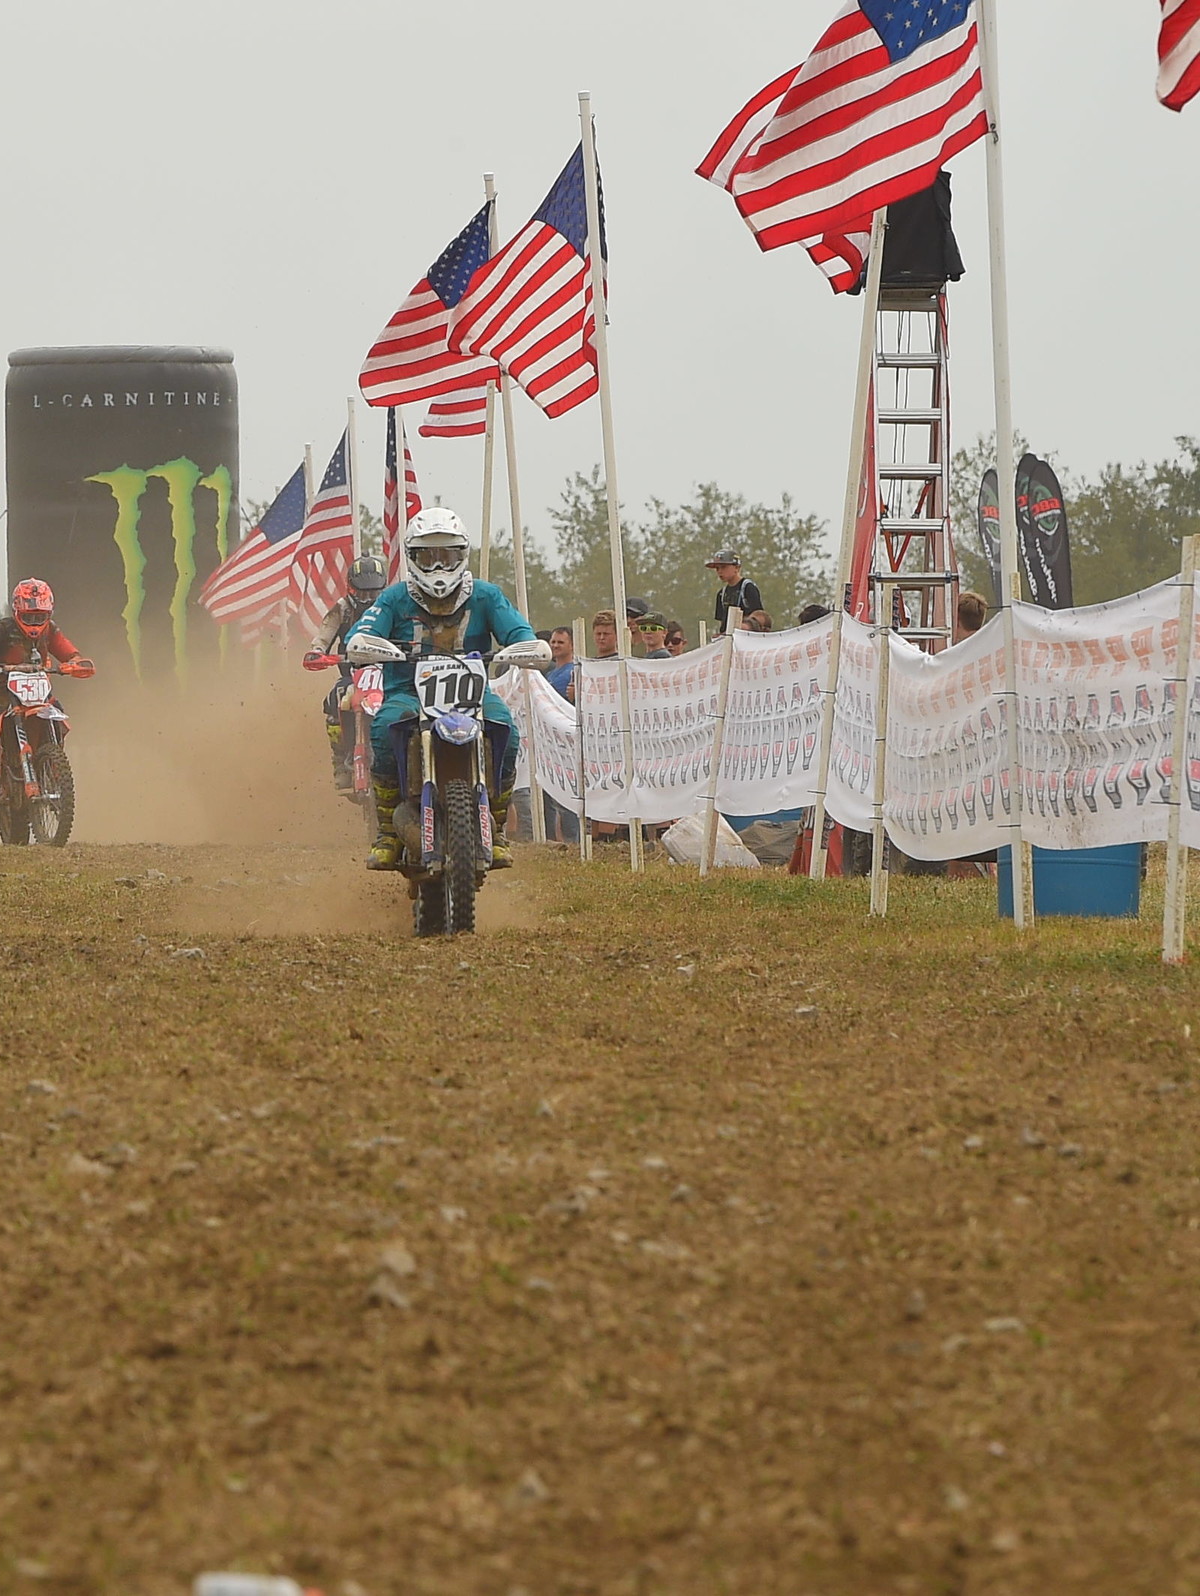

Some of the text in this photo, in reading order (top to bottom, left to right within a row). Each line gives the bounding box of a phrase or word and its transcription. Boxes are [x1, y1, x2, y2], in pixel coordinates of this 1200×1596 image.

[33, 391, 220, 408] L-CARNITINE
[432, 664, 446, 672] IAN
[16, 680, 46, 703] 530
[419, 673, 484, 707] 110
[424, 807, 434, 851] KENDA
[480, 805, 491, 848] KENDA
